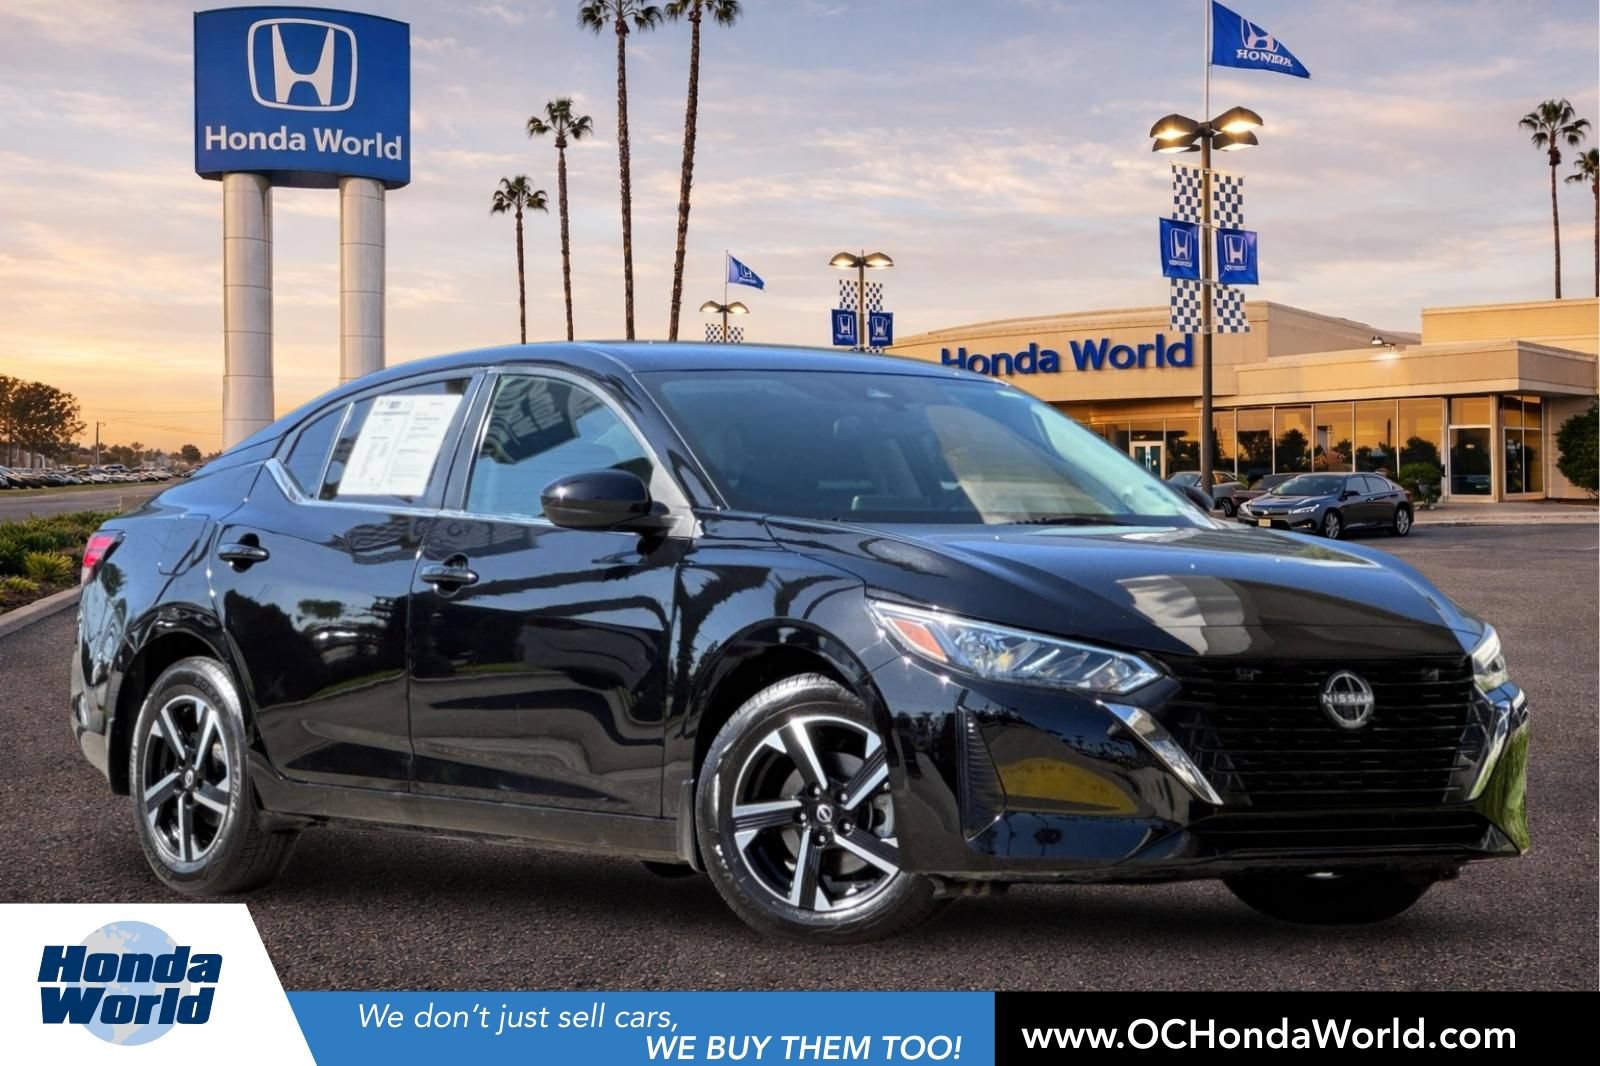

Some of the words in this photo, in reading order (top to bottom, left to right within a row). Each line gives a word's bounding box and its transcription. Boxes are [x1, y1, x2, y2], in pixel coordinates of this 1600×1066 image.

[204, 125, 306, 151] Honda
[313, 127, 402, 161] World
[941, 342, 1061, 376] Honda
[1069, 333, 1194, 371] World
[1322, 693, 1373, 704] NISSAN
